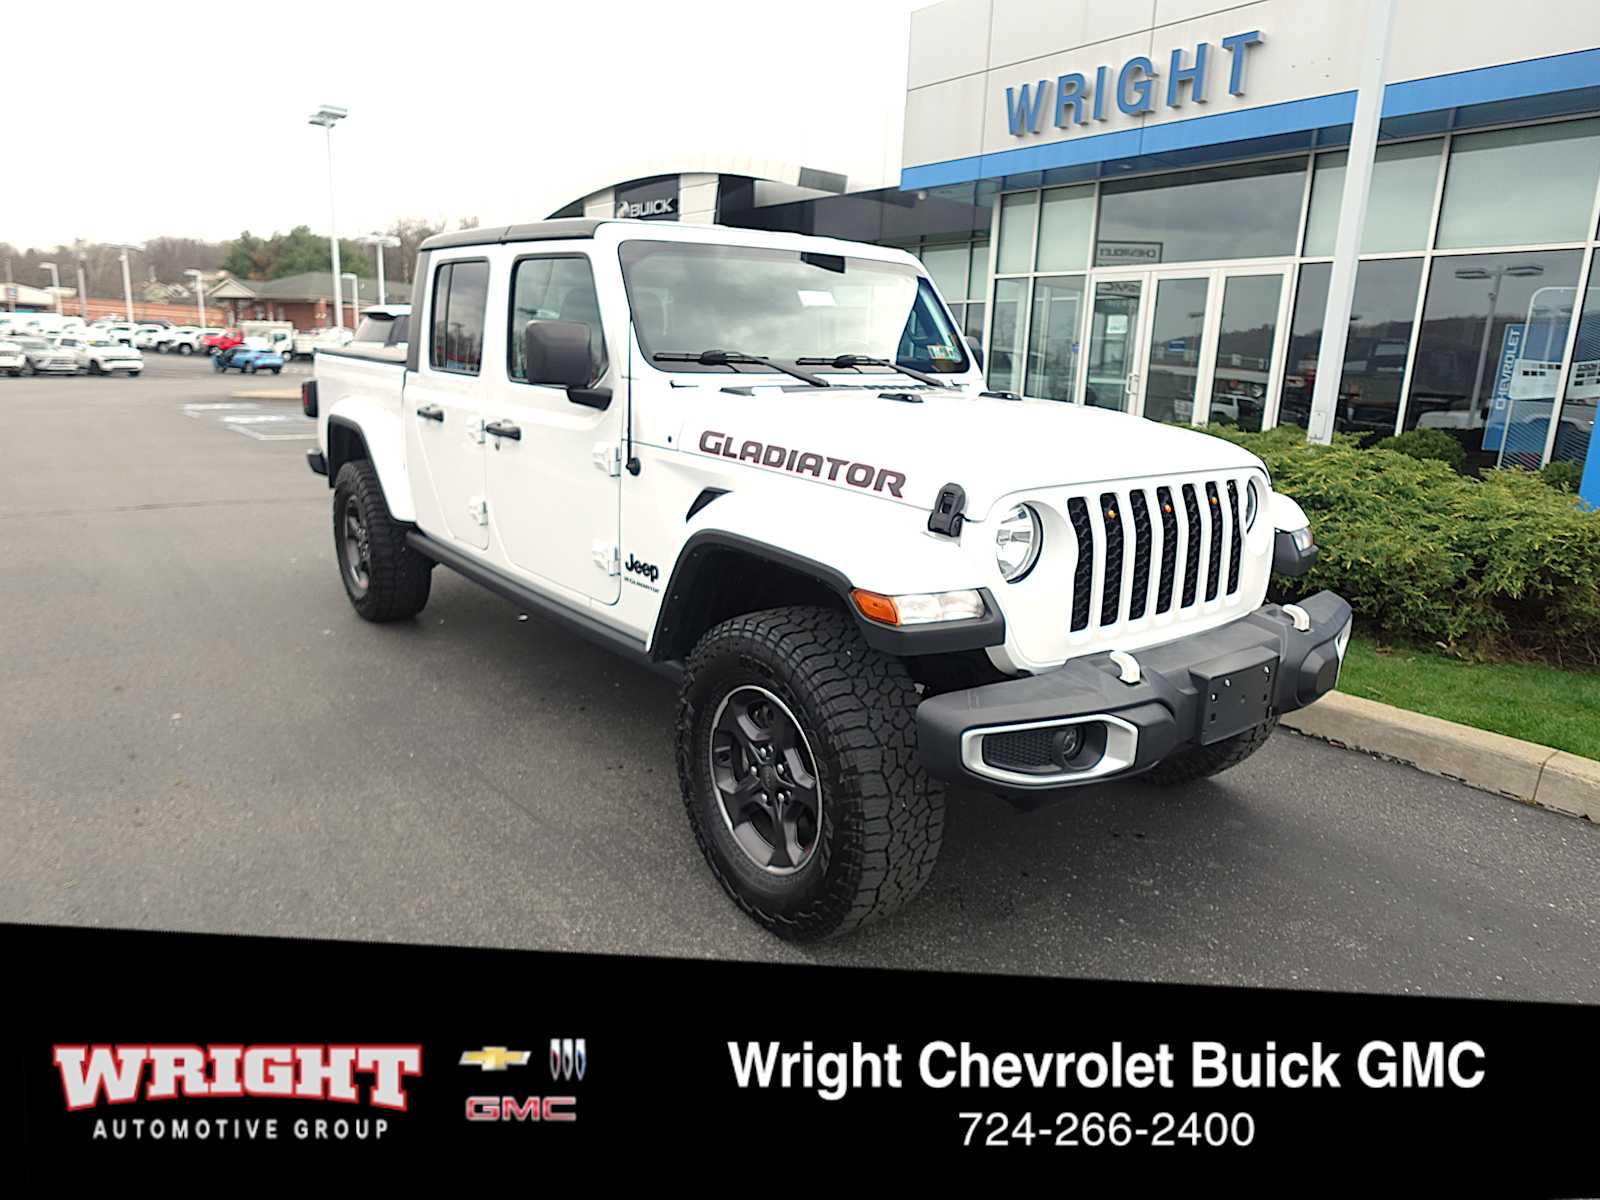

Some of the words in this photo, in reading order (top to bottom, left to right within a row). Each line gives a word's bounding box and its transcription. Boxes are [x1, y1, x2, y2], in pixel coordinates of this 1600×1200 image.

[1006, 30, 1265, 137] WRIGHT
[630, 198, 674, 217] BUICK
[1495, 328, 1521, 411] CHEVROLET
[699, 430, 906, 498] GLADIATOR
[625, 552, 659, 582] Jeep
